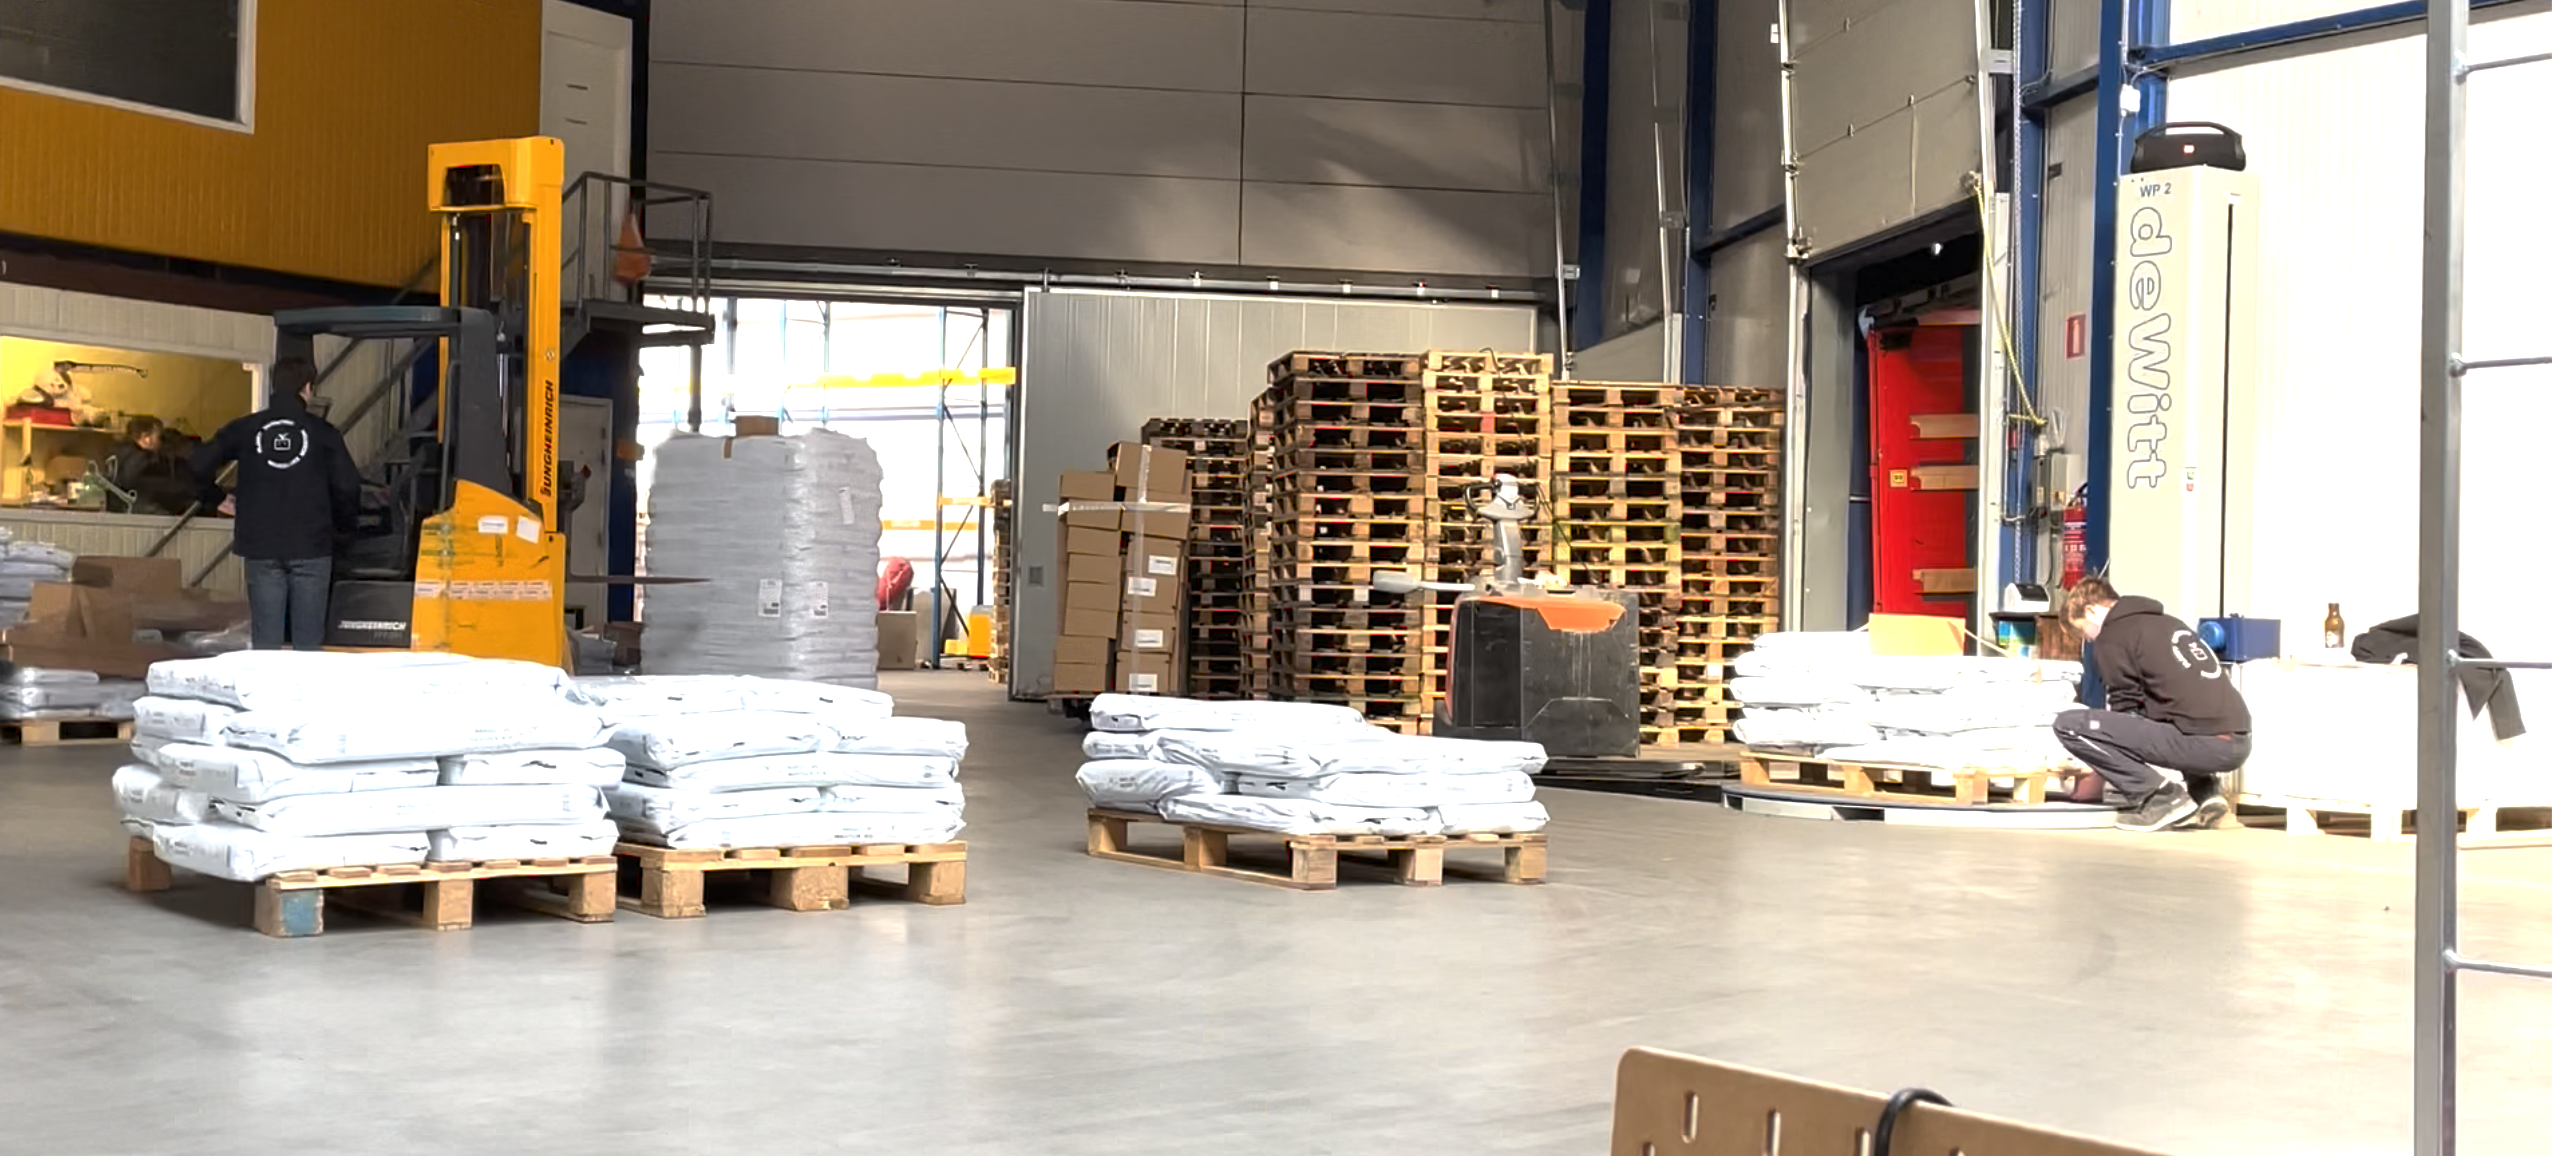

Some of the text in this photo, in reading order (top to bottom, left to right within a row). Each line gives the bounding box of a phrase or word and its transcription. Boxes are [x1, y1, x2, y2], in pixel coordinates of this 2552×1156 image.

[2140, 182, 2172, 197] WP 2
[2127, 206, 2172, 489] deWitt
[540, 379, 554, 497] JUNGHEINRICH
